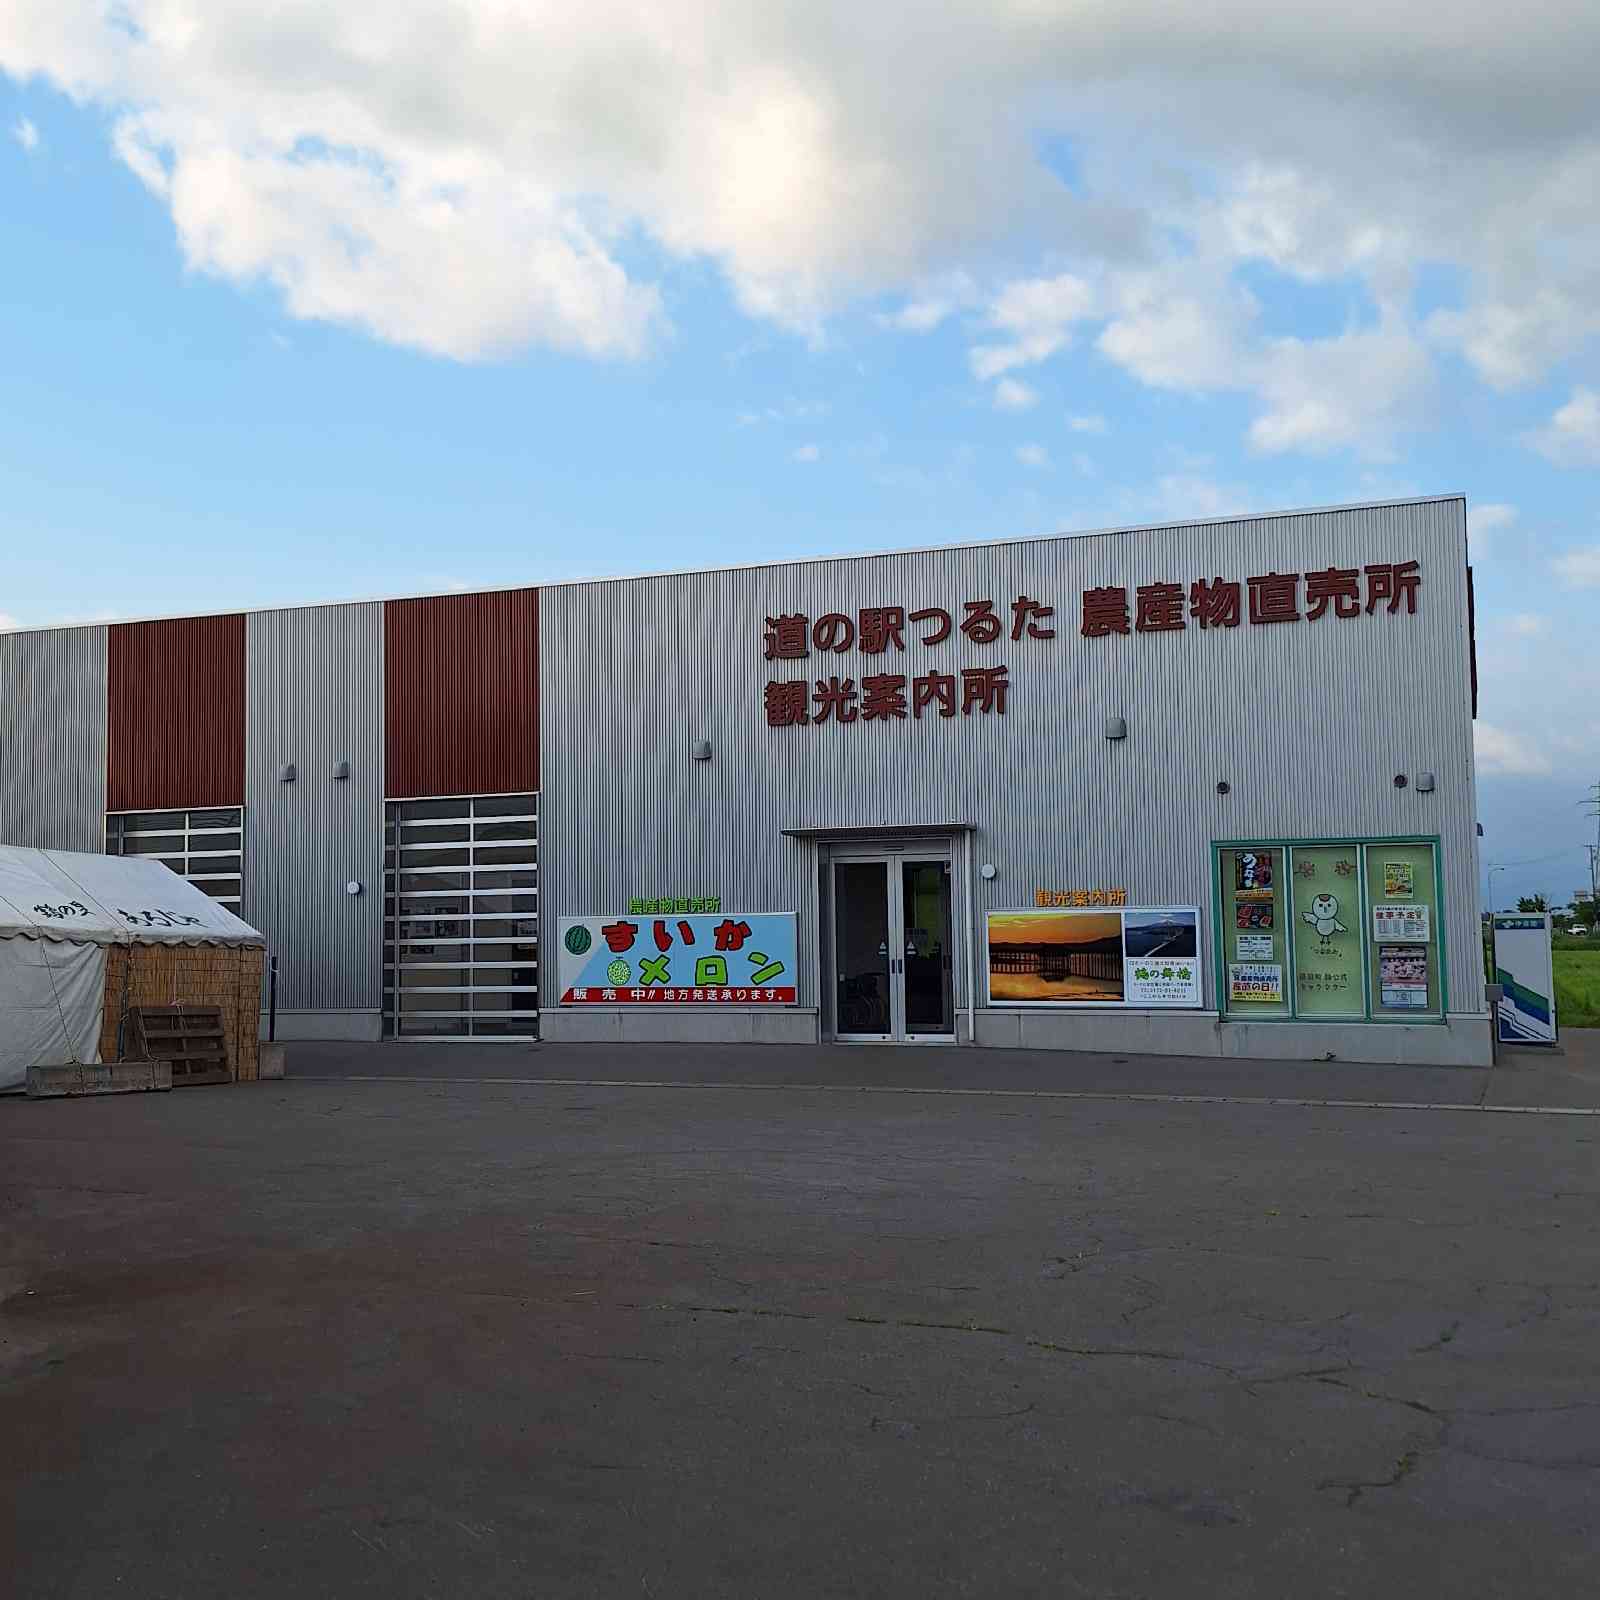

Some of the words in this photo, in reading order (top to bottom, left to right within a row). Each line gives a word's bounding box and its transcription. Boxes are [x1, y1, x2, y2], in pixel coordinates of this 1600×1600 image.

[763, 595, 1055, 660] 道の駅つるた
[1079, 560, 1421, 638] 農産物直売所
[763, 665, 1011, 727] 観光案内所
[628, 896, 721, 915] 農産物直売所
[1034, 888, 1127, 907] 観光案内所
[601, 919, 752, 952] すいか
[638, 951, 785, 987] メロン
